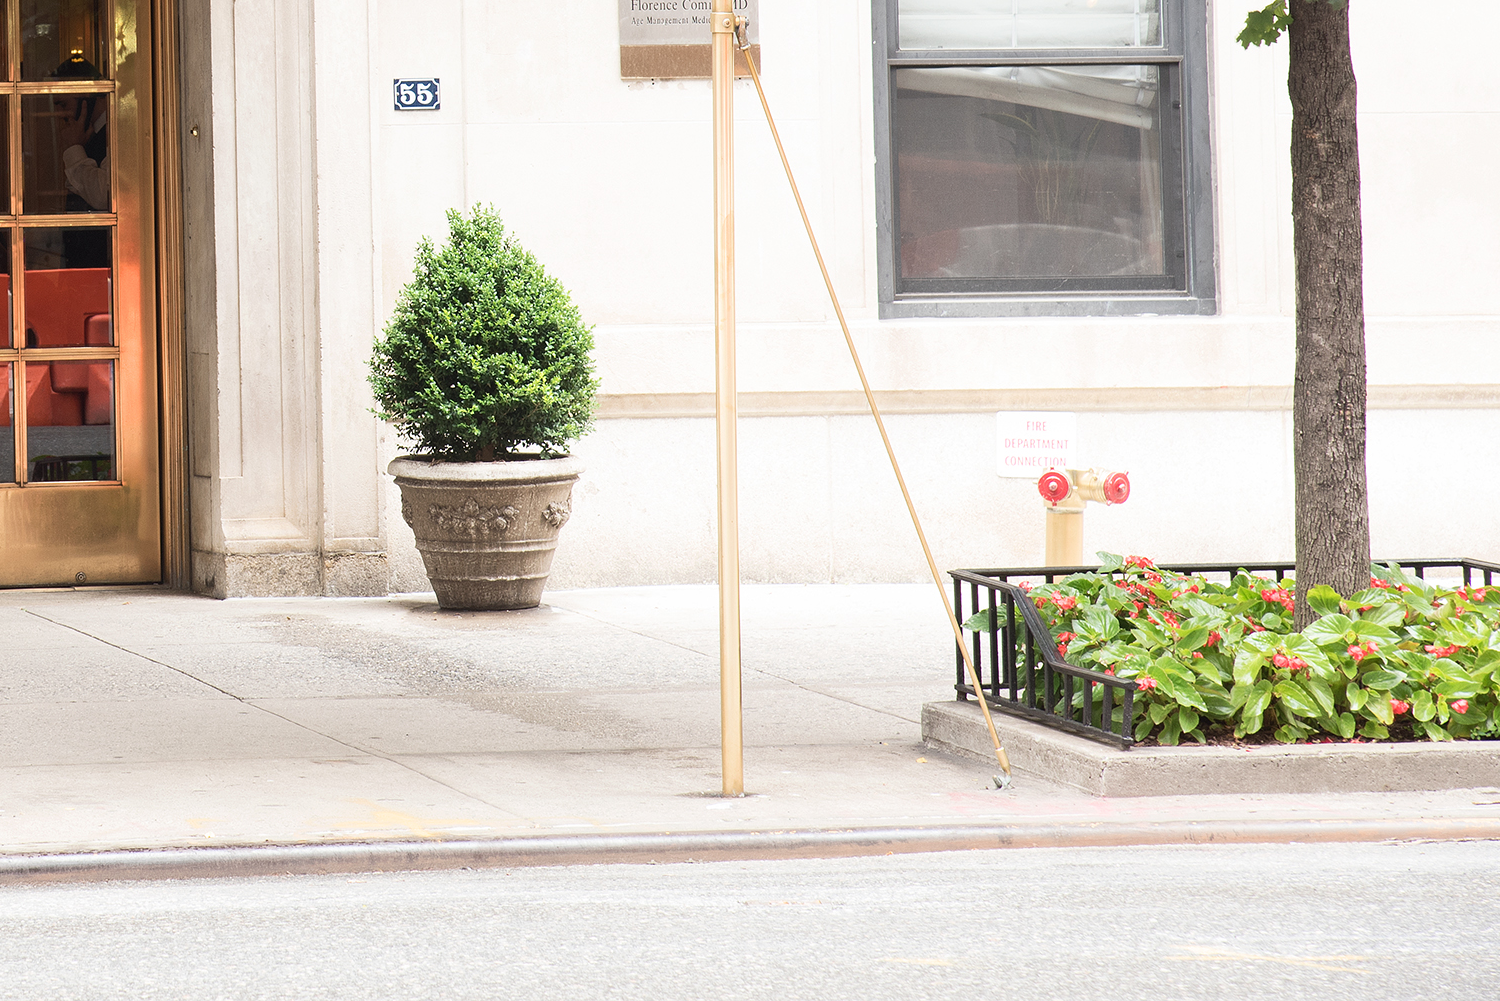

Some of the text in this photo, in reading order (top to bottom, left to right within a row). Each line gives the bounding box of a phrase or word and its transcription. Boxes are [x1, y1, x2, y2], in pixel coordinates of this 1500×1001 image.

[630, 0, 678, 11] Florence
[630, 16, 644, 26] Age
[646, 15, 689, 26] Management
[400, 82, 434, 105] 55
[1025, 420, 1048, 432] FIRE
[1004, 438, 1069, 450] DEPARTMENT
[1004, 455, 1067, 467] CONNECTION
